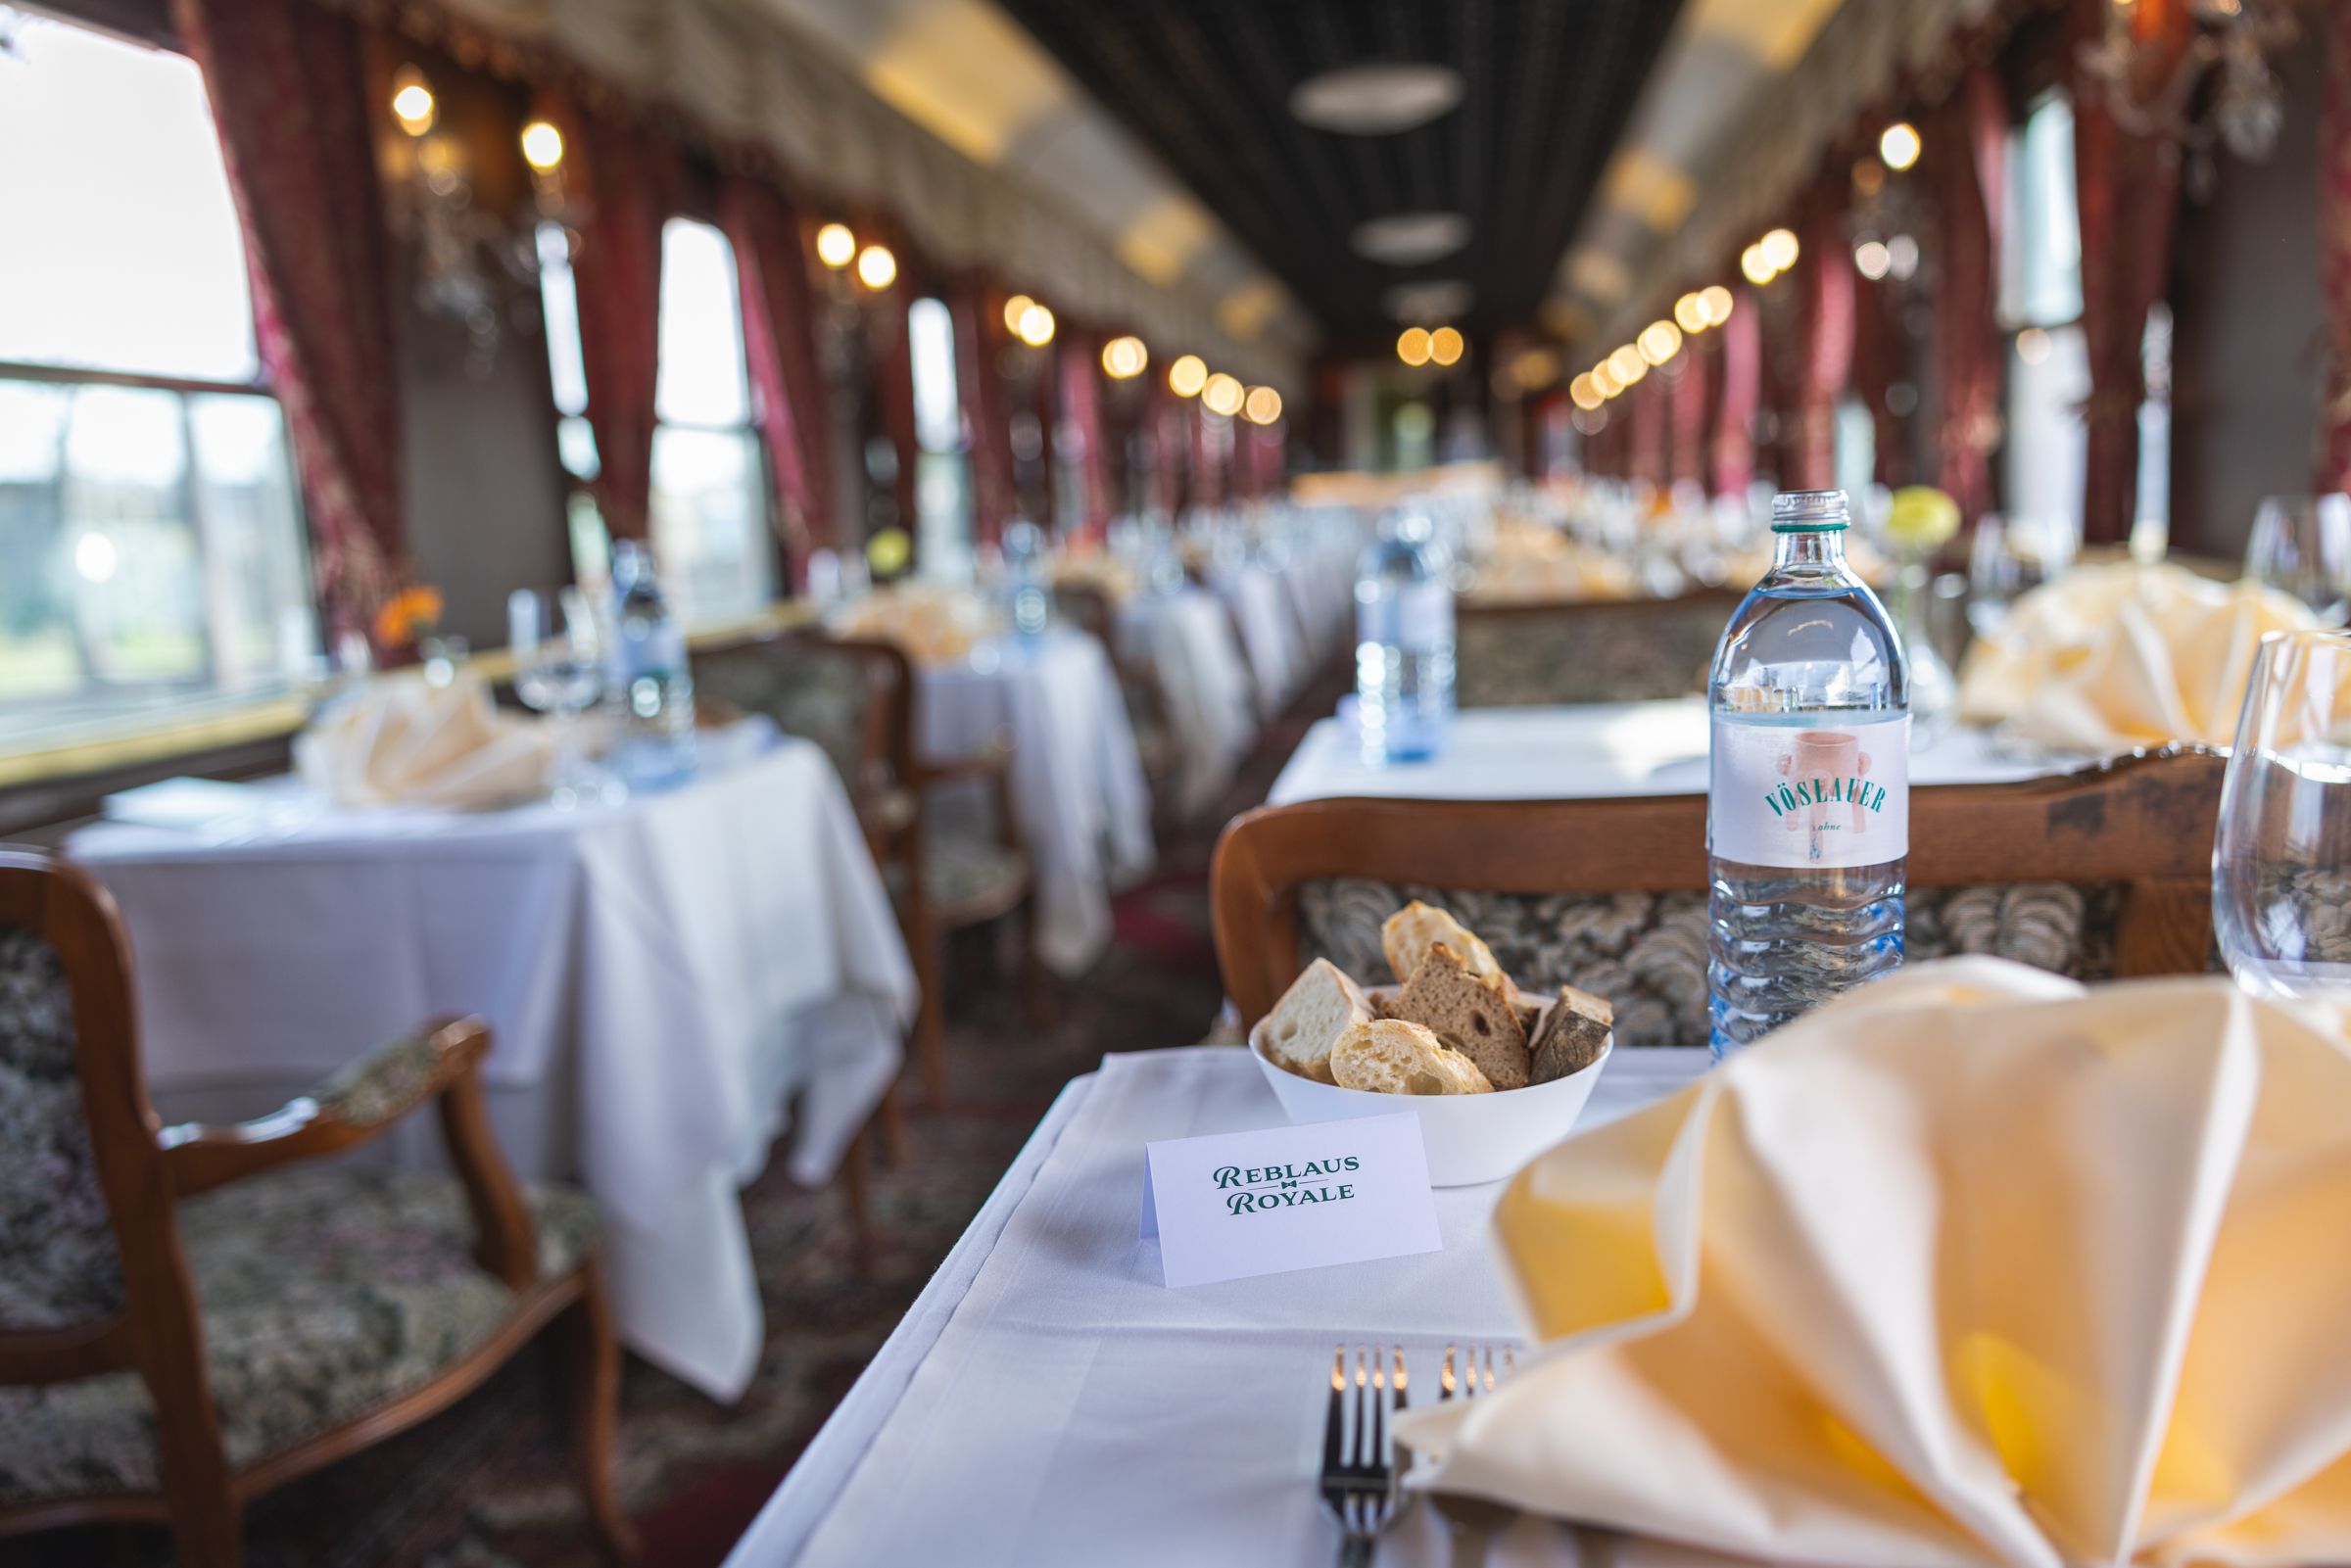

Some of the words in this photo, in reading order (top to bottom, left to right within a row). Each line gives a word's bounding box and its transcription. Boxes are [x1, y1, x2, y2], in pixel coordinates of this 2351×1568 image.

[1764, 778, 1886, 817] VÖSLAUER
[1817, 822, 1842, 832] ohne
[1213, 1156, 1360, 1189] REBLAUS
[1226, 1184, 1355, 1215] ROYALE
